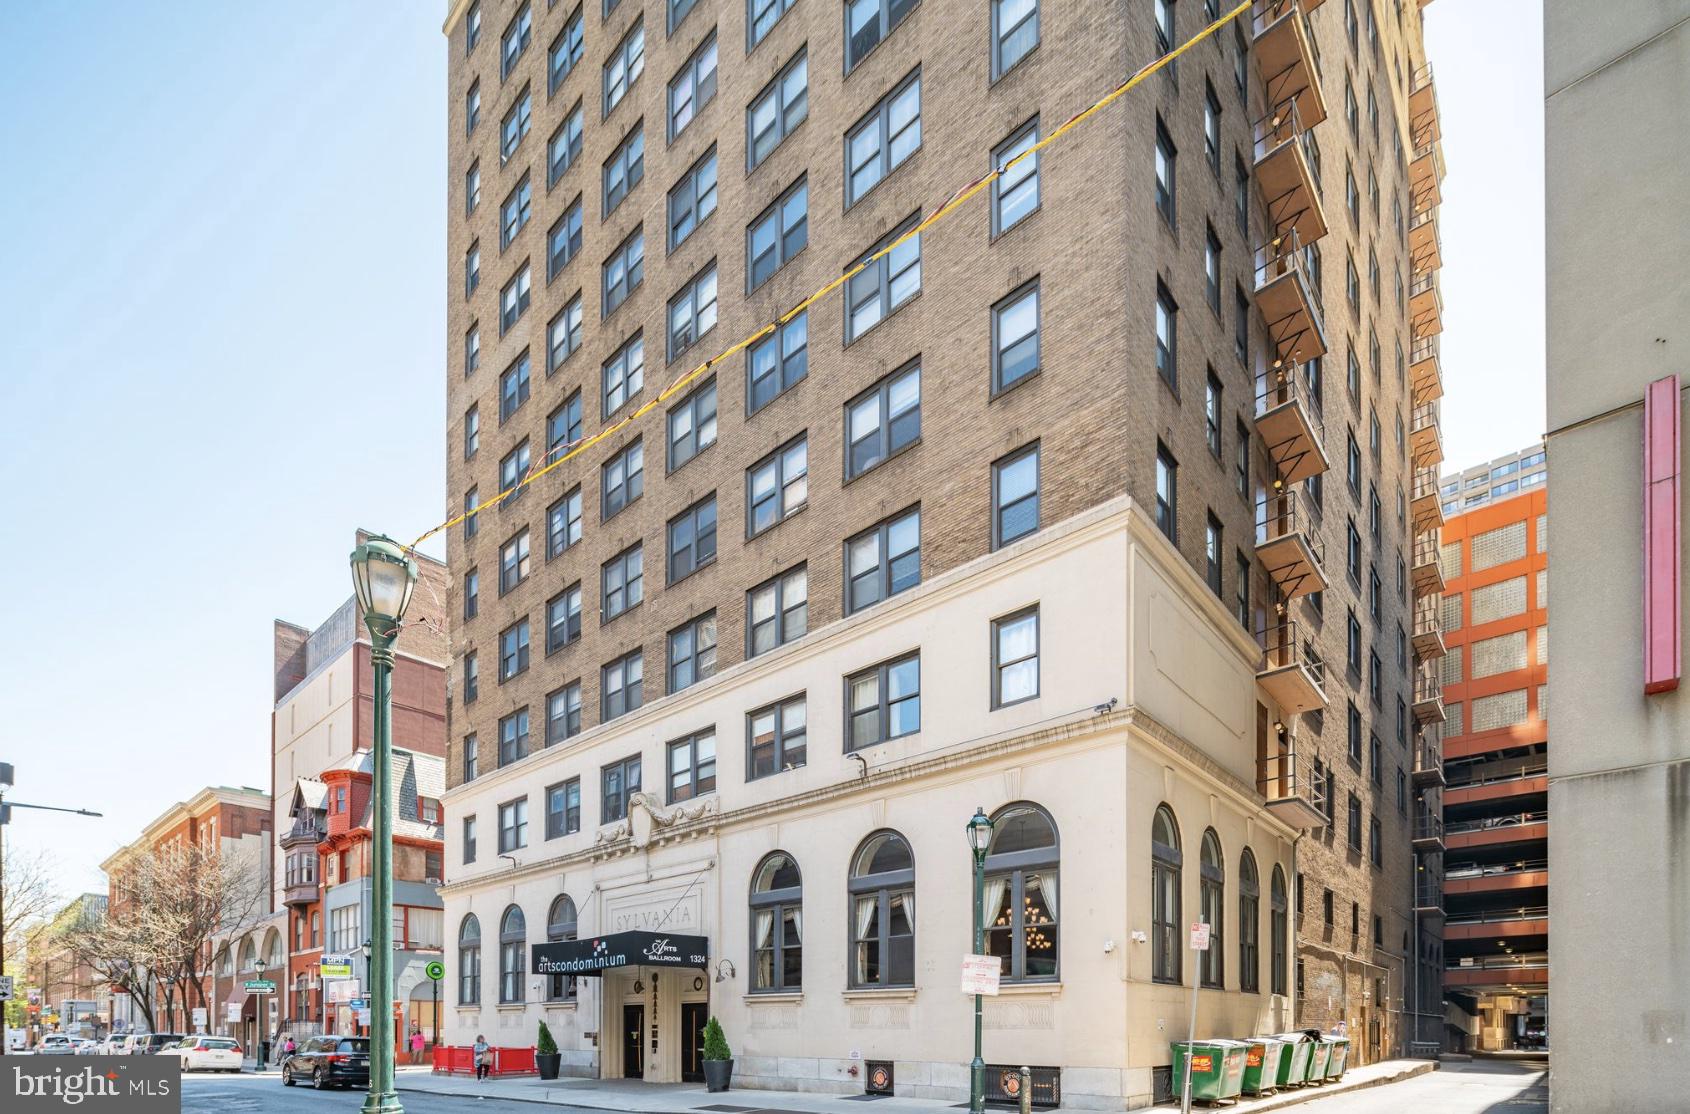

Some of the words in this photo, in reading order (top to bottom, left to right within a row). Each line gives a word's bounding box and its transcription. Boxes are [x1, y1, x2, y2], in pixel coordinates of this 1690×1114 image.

[616, 906, 691, 931] SYLVANIA
[538, 953, 626, 972] artscondominium
[689, 954, 706, 963] 1324
